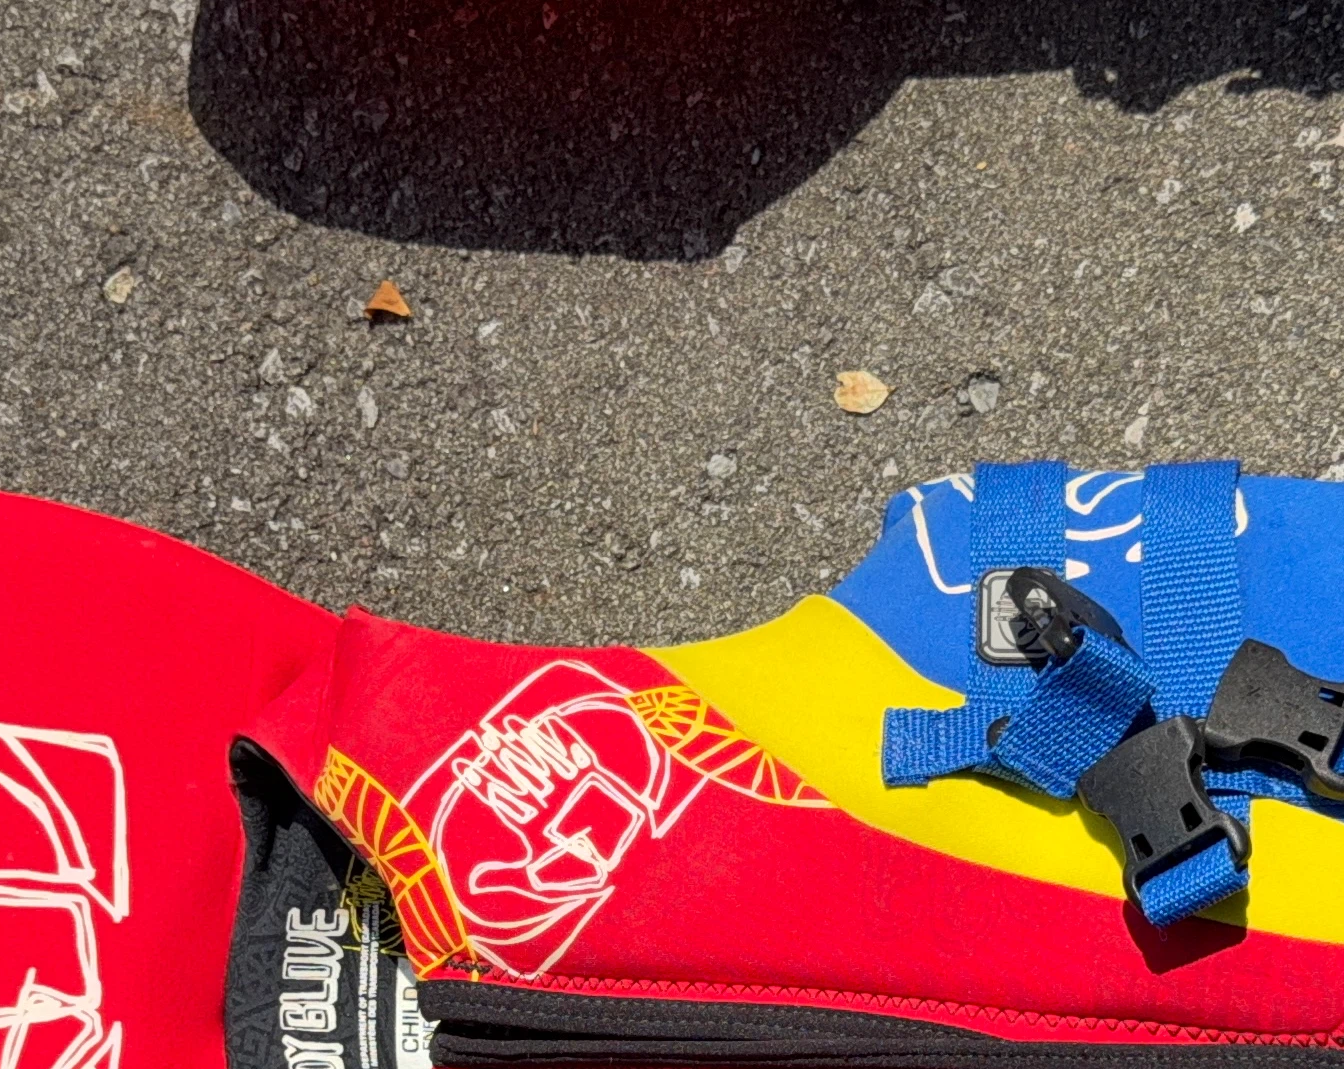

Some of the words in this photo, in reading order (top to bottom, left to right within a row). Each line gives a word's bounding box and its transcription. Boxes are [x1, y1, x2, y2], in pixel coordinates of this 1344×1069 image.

[358, 944, 369, 996] TRANSPORT
[358, 996, 368, 1009] OF
[401, 986, 419, 1053] CHILD
[358, 1010, 370, 1069] DEPARTMENT
